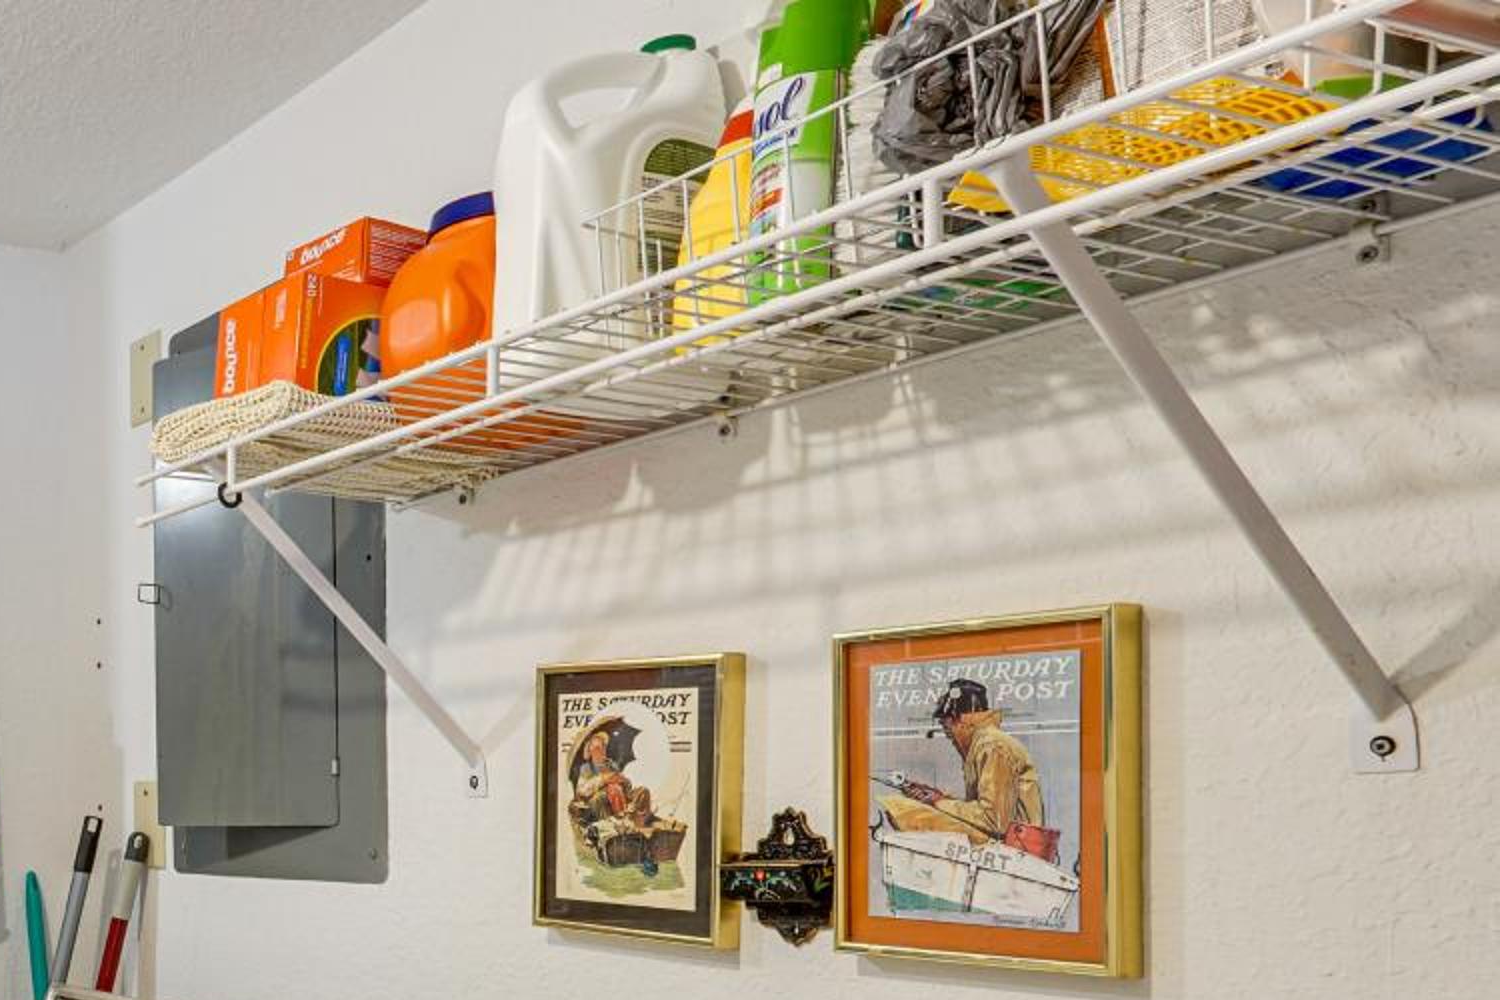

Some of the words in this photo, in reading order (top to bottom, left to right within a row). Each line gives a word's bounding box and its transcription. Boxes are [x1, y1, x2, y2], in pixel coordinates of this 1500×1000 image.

[222, 318, 238, 395] bounce
[875, 667, 923, 688] THE
[929, 657, 1073, 684] SATURDAY
[562, 697, 593, 713] THE
[876, 686, 946, 708] EVEN
[996, 680, 1074, 702] POST
[944, 842, 1013, 871] SPORT
